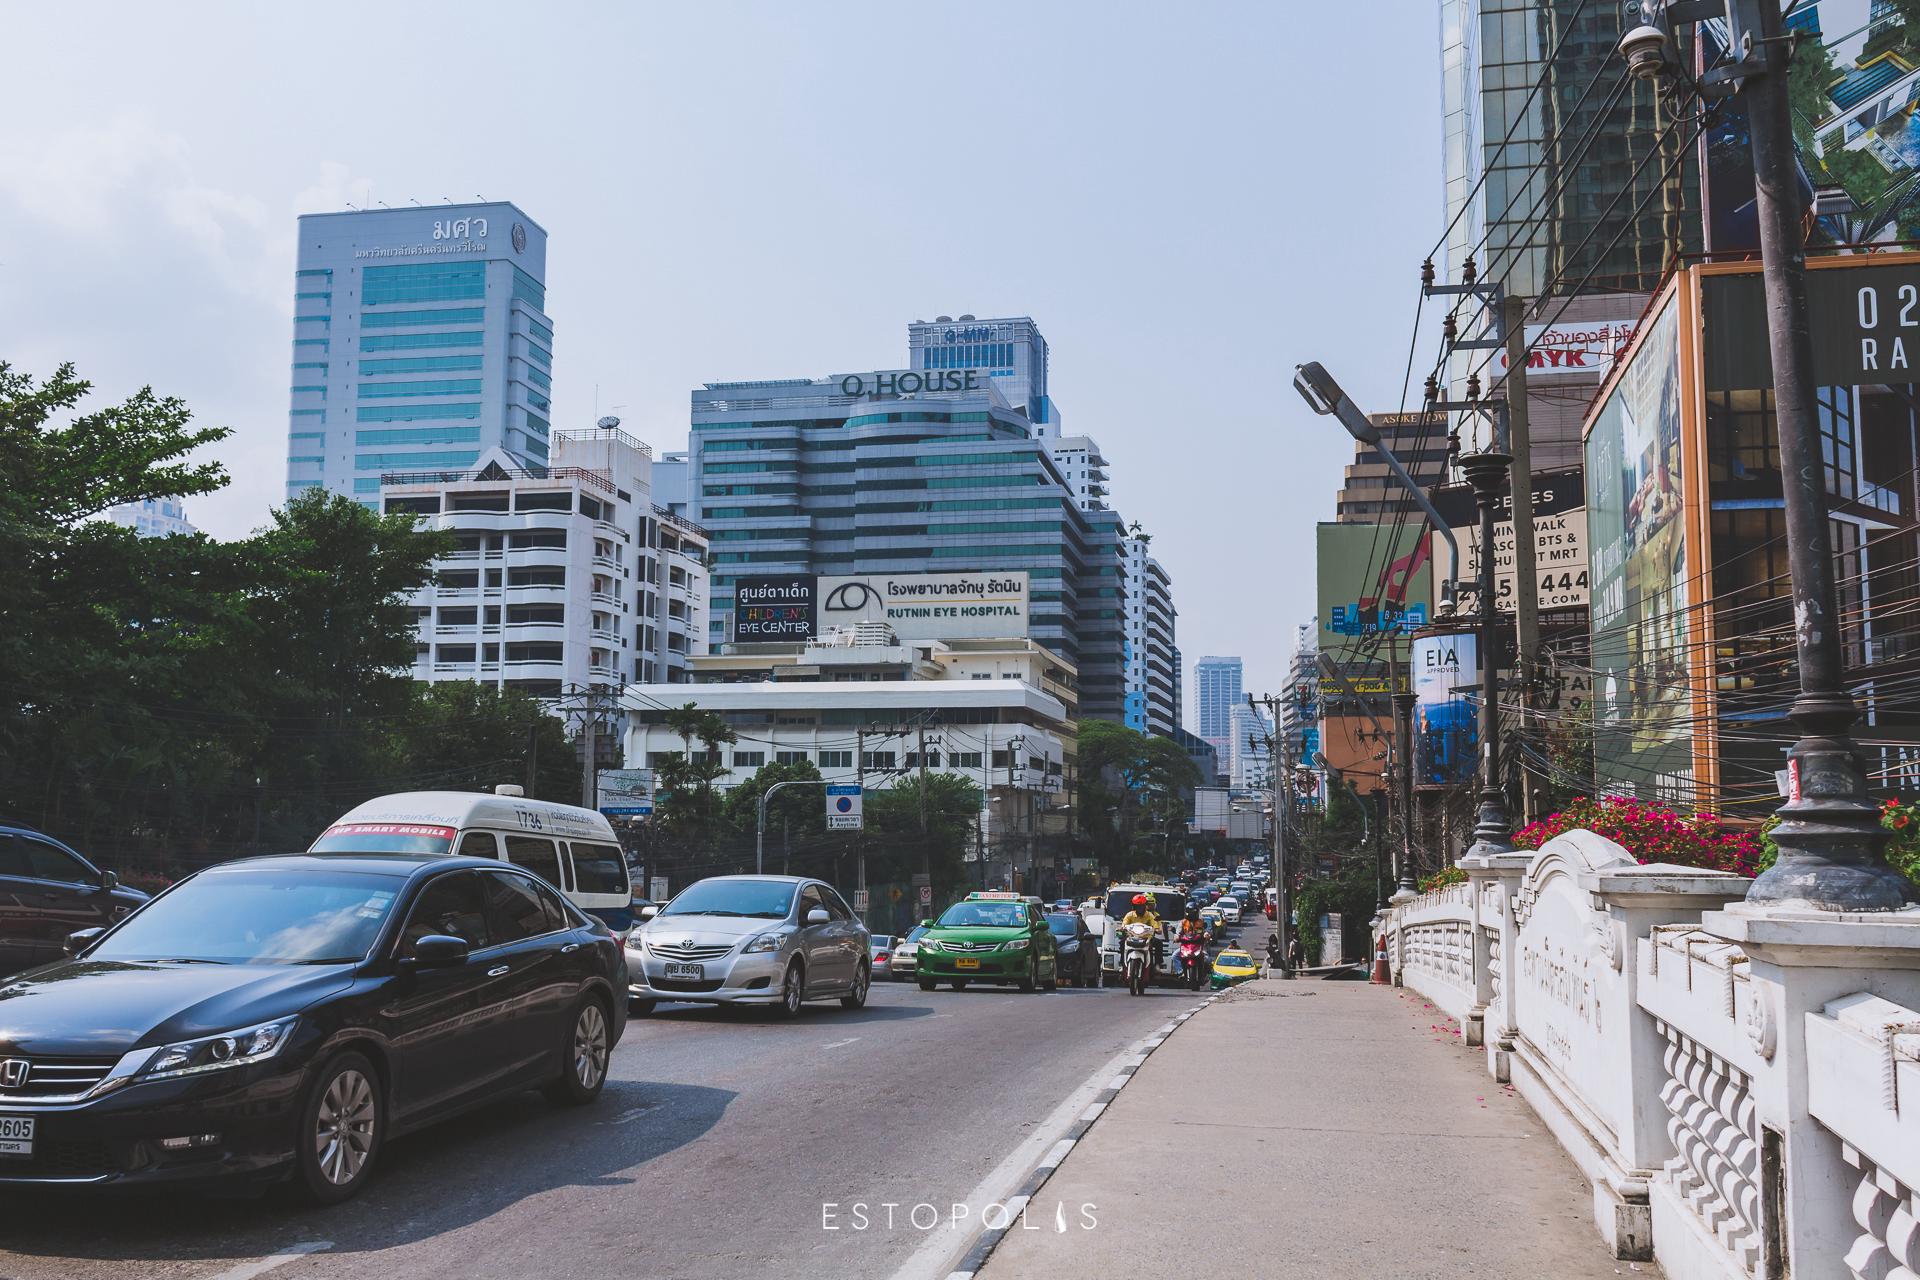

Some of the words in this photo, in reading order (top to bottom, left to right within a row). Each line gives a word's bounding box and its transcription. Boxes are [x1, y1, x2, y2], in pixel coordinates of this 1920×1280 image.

[433, 217, 488, 240] มศว
[842, 369, 980, 397] Q.HOUSE
[1382, 414, 1417, 424] ASOKE
[1539, 535, 1562, 546] BTS
[1567, 533, 1577, 543] &
[1550, 548, 1578, 560] MRT
[740, 583, 808, 603] ศูนย์ตาเด็ก
[888, 579, 984, 598] โรงพยาบาลจักษุ
[988, 579, 1021, 593] รัตนิน
[740, 607, 808, 620] CHILDREN'S
[888, 608, 930, 618] RUTNIN
[934, 607, 957, 617] EYE
[961, 606, 1020, 616] HOSPITAL
[739, 624, 759, 633] EYE
[761, 621, 810, 634] CENTER
[1427, 648, 1459, 666] EIA
[516, 811, 543, 829] 1736
[399, 827, 447, 836] MOBILE
[681, 965, 700, 974] 6500
[0, 1119, 32, 1138] 605
